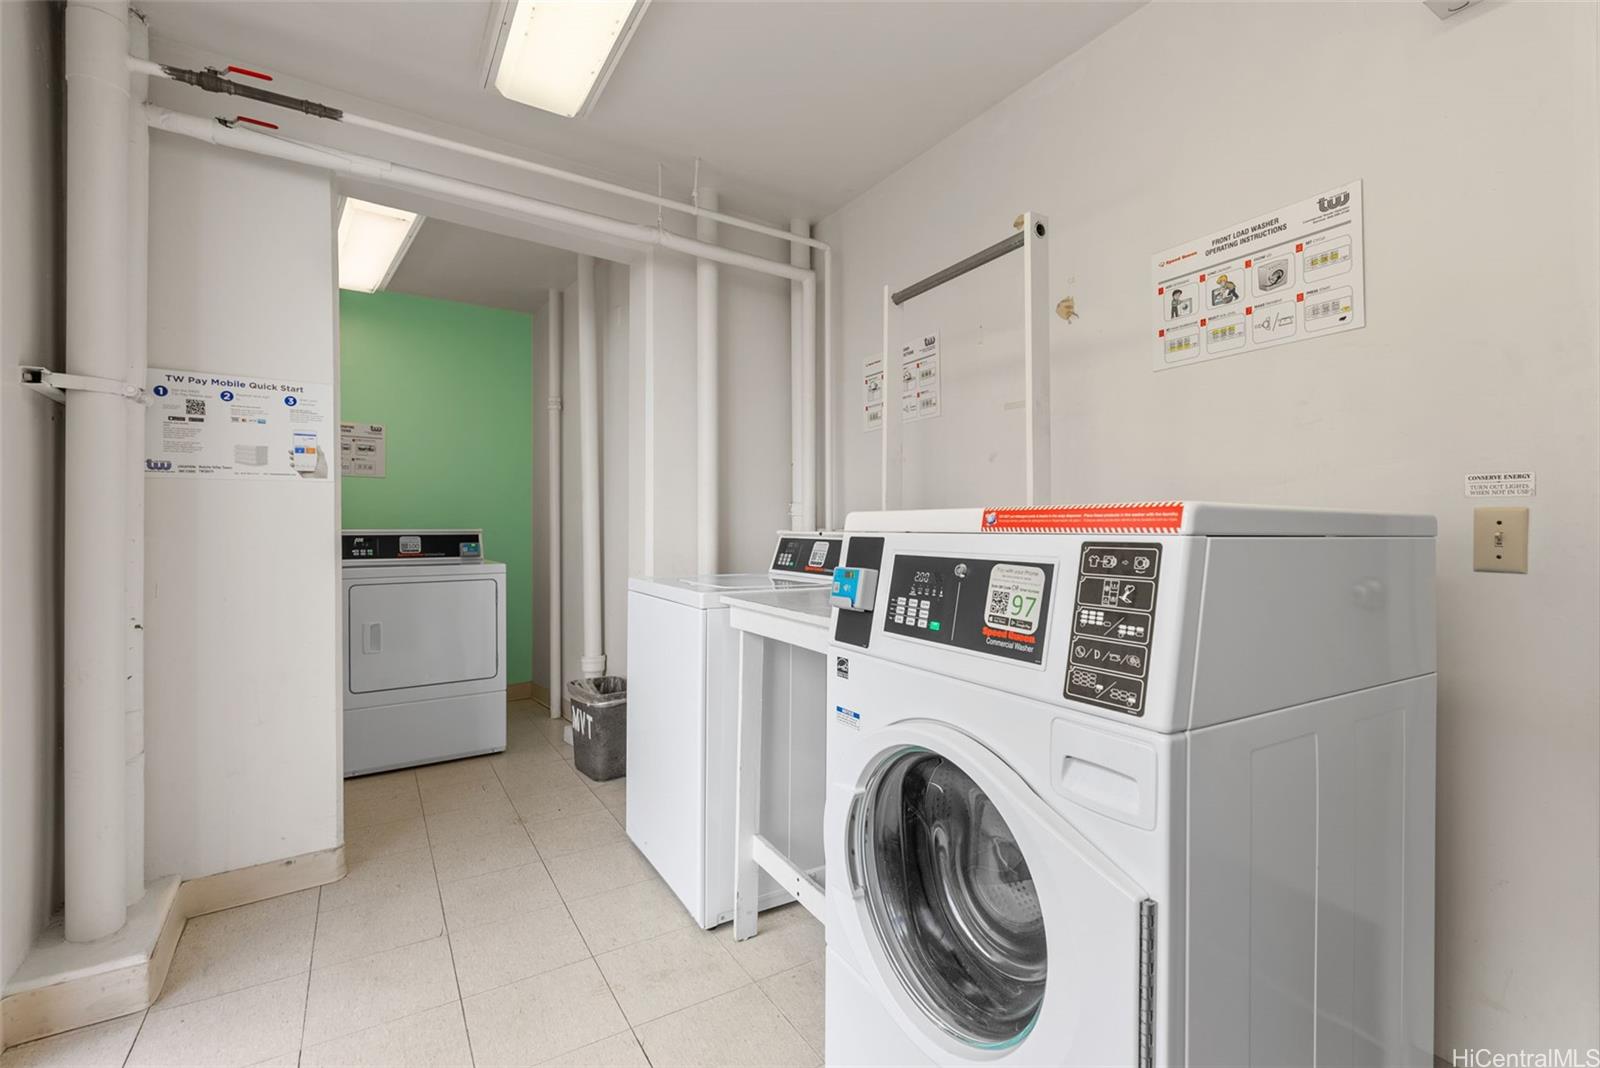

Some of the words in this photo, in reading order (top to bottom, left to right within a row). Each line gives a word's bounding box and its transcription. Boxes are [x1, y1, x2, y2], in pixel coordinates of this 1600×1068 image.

[1205, 241, 1238, 256] OPERATING
[1239, 224, 1287, 245] INSTRUCTIONS
[1211, 234, 1231, 246] FRONT
[1233, 228, 1249, 239] LOAD
[1250, 217, 1279, 233] WASHER
[165, 374, 185, 383] TW
[188, 376, 208, 385] Pay
[211, 379, 246, 388] Mobile
[249, 382, 277, 391] Quick
[280, 384, 304, 393] Start
[1011, 594, 1037, 618] 97
[986, 637, 1014, 648] Commercial
[1014, 642, 1034, 652] Washer
[571, 705, 593, 740] MVT
